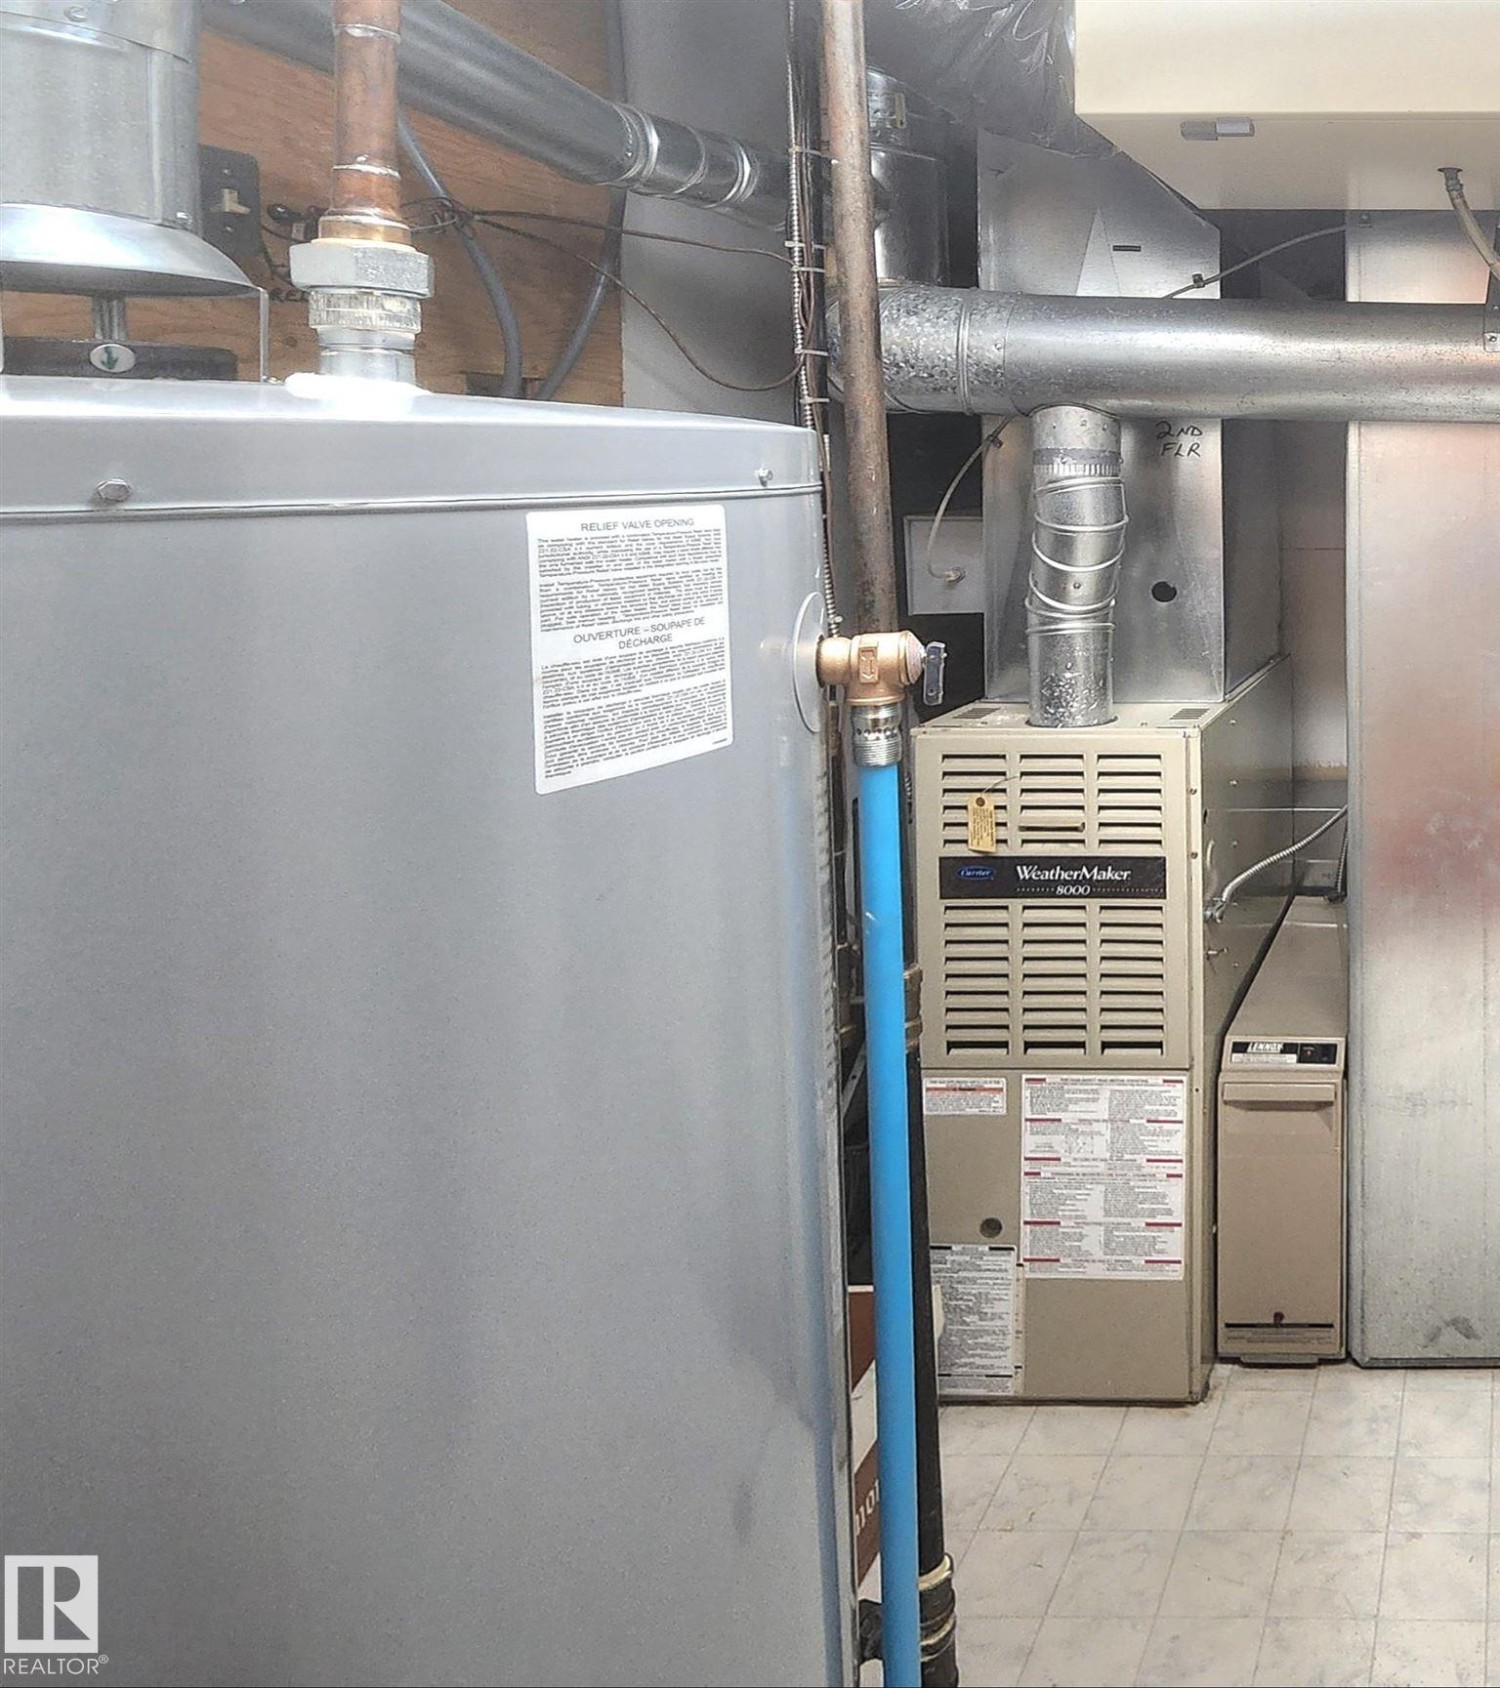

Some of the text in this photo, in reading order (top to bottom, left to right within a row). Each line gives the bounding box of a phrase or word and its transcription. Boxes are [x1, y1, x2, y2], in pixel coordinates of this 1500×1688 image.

[1155, 420, 1204, 440] 2ND
[1160, 442, 1202, 457] FLR
[581, 518, 695, 532] RELIEF VALVE OPENING
[573, 626, 641, 644] OUVERTURE
[651, 618, 693, 633] SOUPAPE
[693, 617, 706, 627] DE
[618, 633, 673, 650] DÉCHARGE
[960, 867, 991, 878] Carrier
[1016, 865, 1131, 881] WeatherMaker
[1056, 885, 1091, 896] 8000
